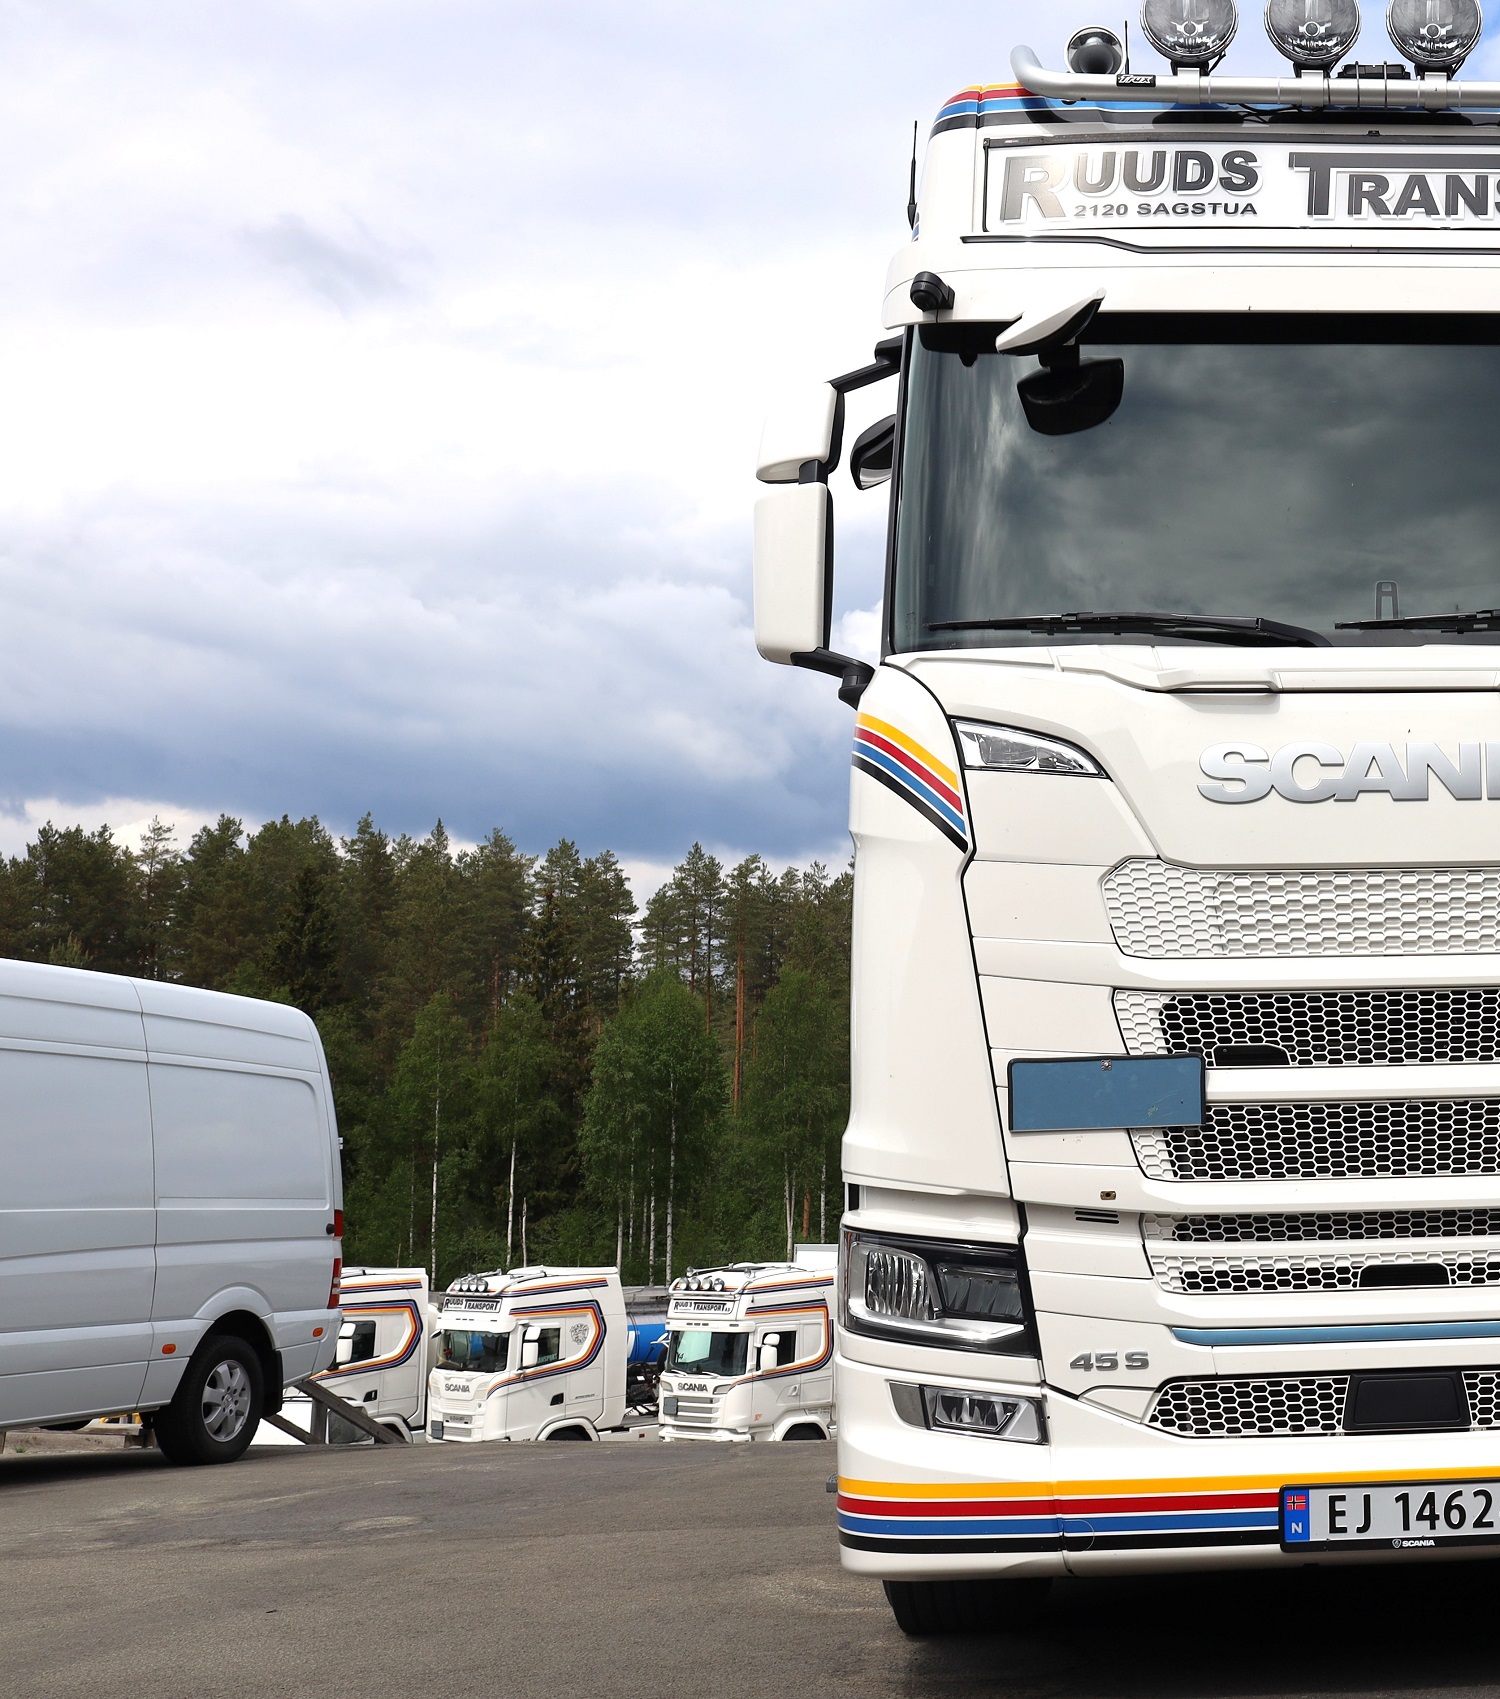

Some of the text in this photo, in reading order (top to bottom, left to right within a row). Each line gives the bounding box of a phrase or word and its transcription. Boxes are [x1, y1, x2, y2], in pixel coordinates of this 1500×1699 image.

[1000, 150, 1262, 222] RUUDS
[1073, 202, 1258, 218] 2120 SAGSTUA
[464, 1298, 501, 1311] TRANSPORT
[693, 1301, 728, 1312] TRANSPORT
[1069, 1350, 1150, 1371] 45 S
[444, 1383, 471, 1393] SCANIA
[677, 1382, 708, 1393] SCANIA
[1327, 1493, 1372, 1534] EJ
[1291, 1522, 1303, 1534] N
[1402, 1539, 1435, 1548] SCANIA
